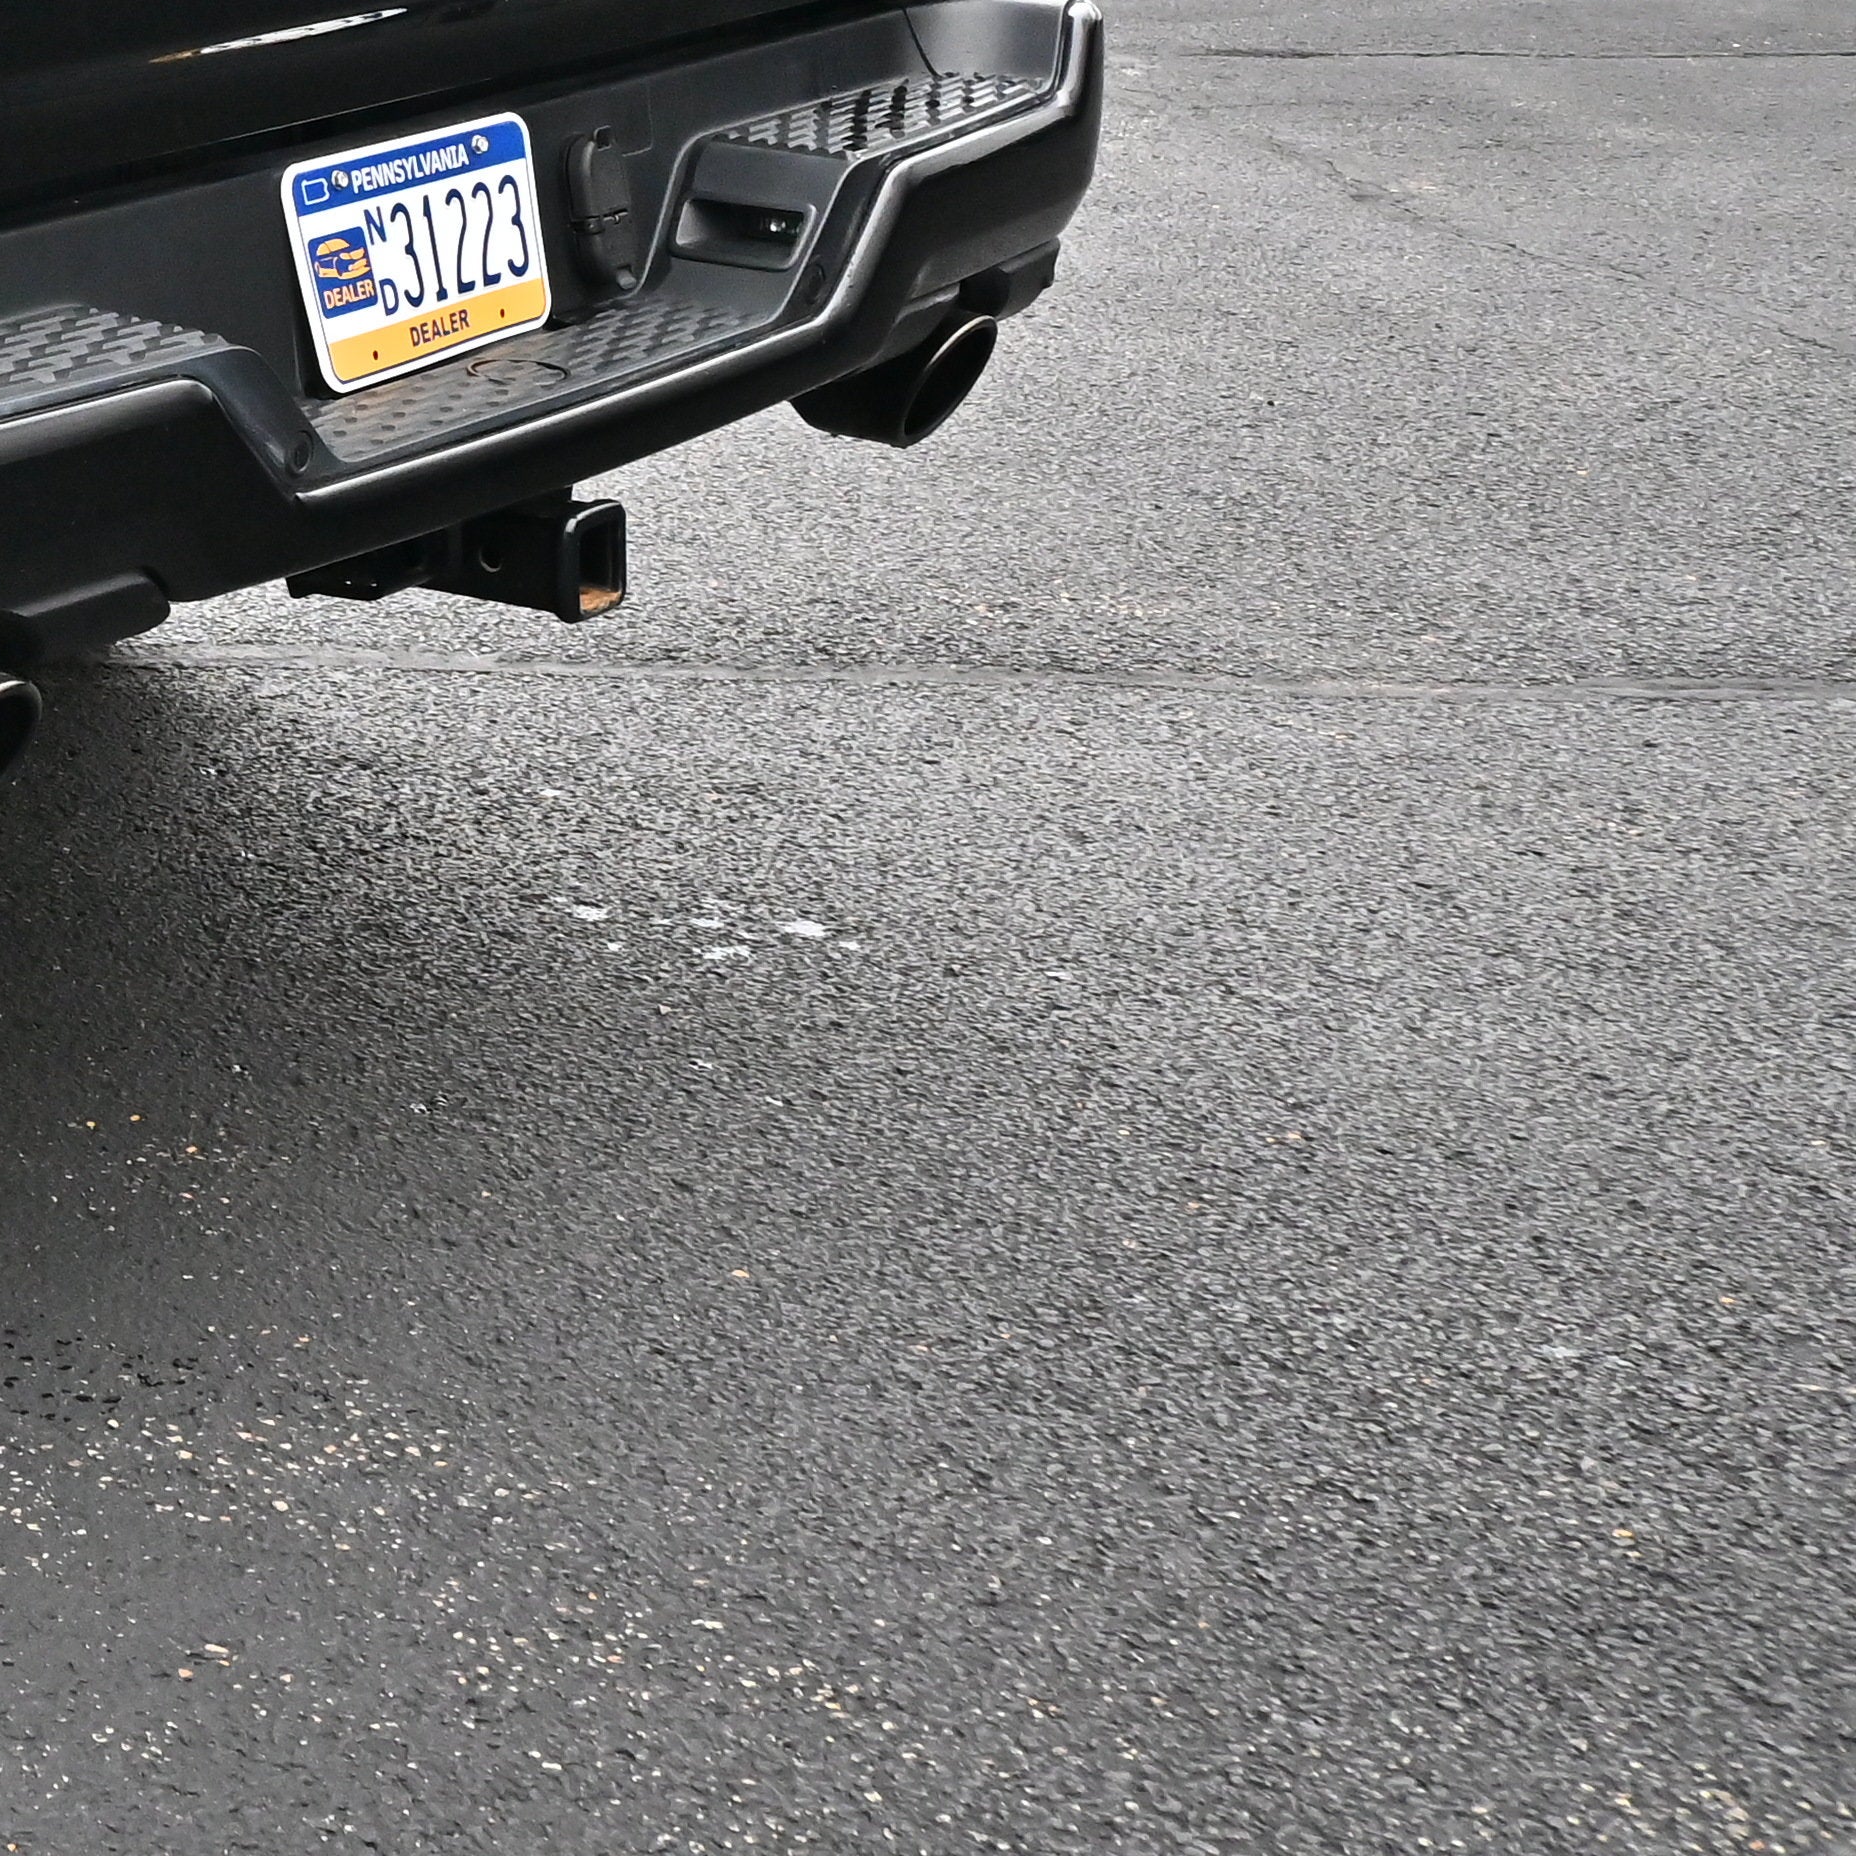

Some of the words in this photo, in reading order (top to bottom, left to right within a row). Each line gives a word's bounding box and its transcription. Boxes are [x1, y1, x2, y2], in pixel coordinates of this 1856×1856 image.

[351, 143, 470, 194] PENNSYLVANIA
[323, 279, 375, 310] DEALER
[409, 308, 470, 348] DEALER
